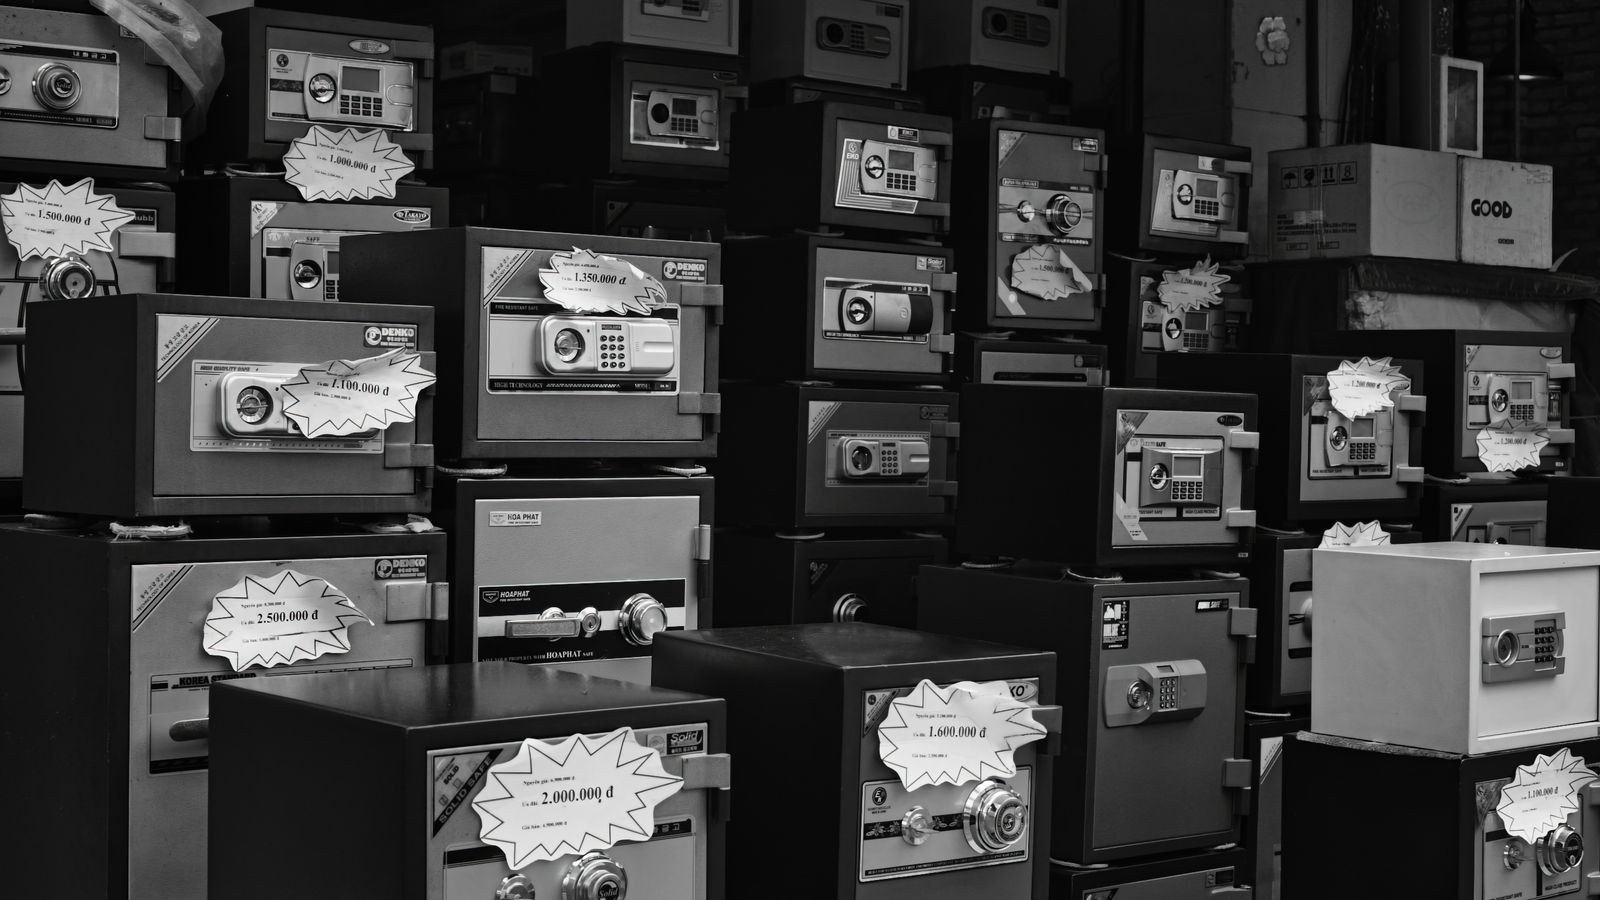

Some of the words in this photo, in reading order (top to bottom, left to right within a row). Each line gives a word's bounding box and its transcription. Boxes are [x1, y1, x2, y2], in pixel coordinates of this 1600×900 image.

[330, 154, 368, 171] 1.000.000
[1471, 198, 1512, 218] GOOD
[38, 209, 82, 224] 1.500.000
[677, 263, 705, 271] DENKO
[575, 272, 617, 284] 1.350.000
[381, 327, 414, 337] DENKO
[332, 379, 380, 395] 1.100.000
[507, 513, 521, 521] HOA
[392, 558, 426, 568] DENKO
[500, 590, 530, 598] HOAPHAT
[257, 610, 308, 624] 2.500.000
[546, 650, 581, 659] HOAPHAT
[179, 675, 209, 686] KOREA
[670, 731, 698, 743] Solid
[929, 726, 976, 738] 1.600.000
[443, 765, 459, 785] SOLID
[439, 788, 467, 823] SOLID
[467, 755, 492, 787] SAFE
[541, 786, 602, 804] 2.000.000
[599, 887, 618, 898] Solid
